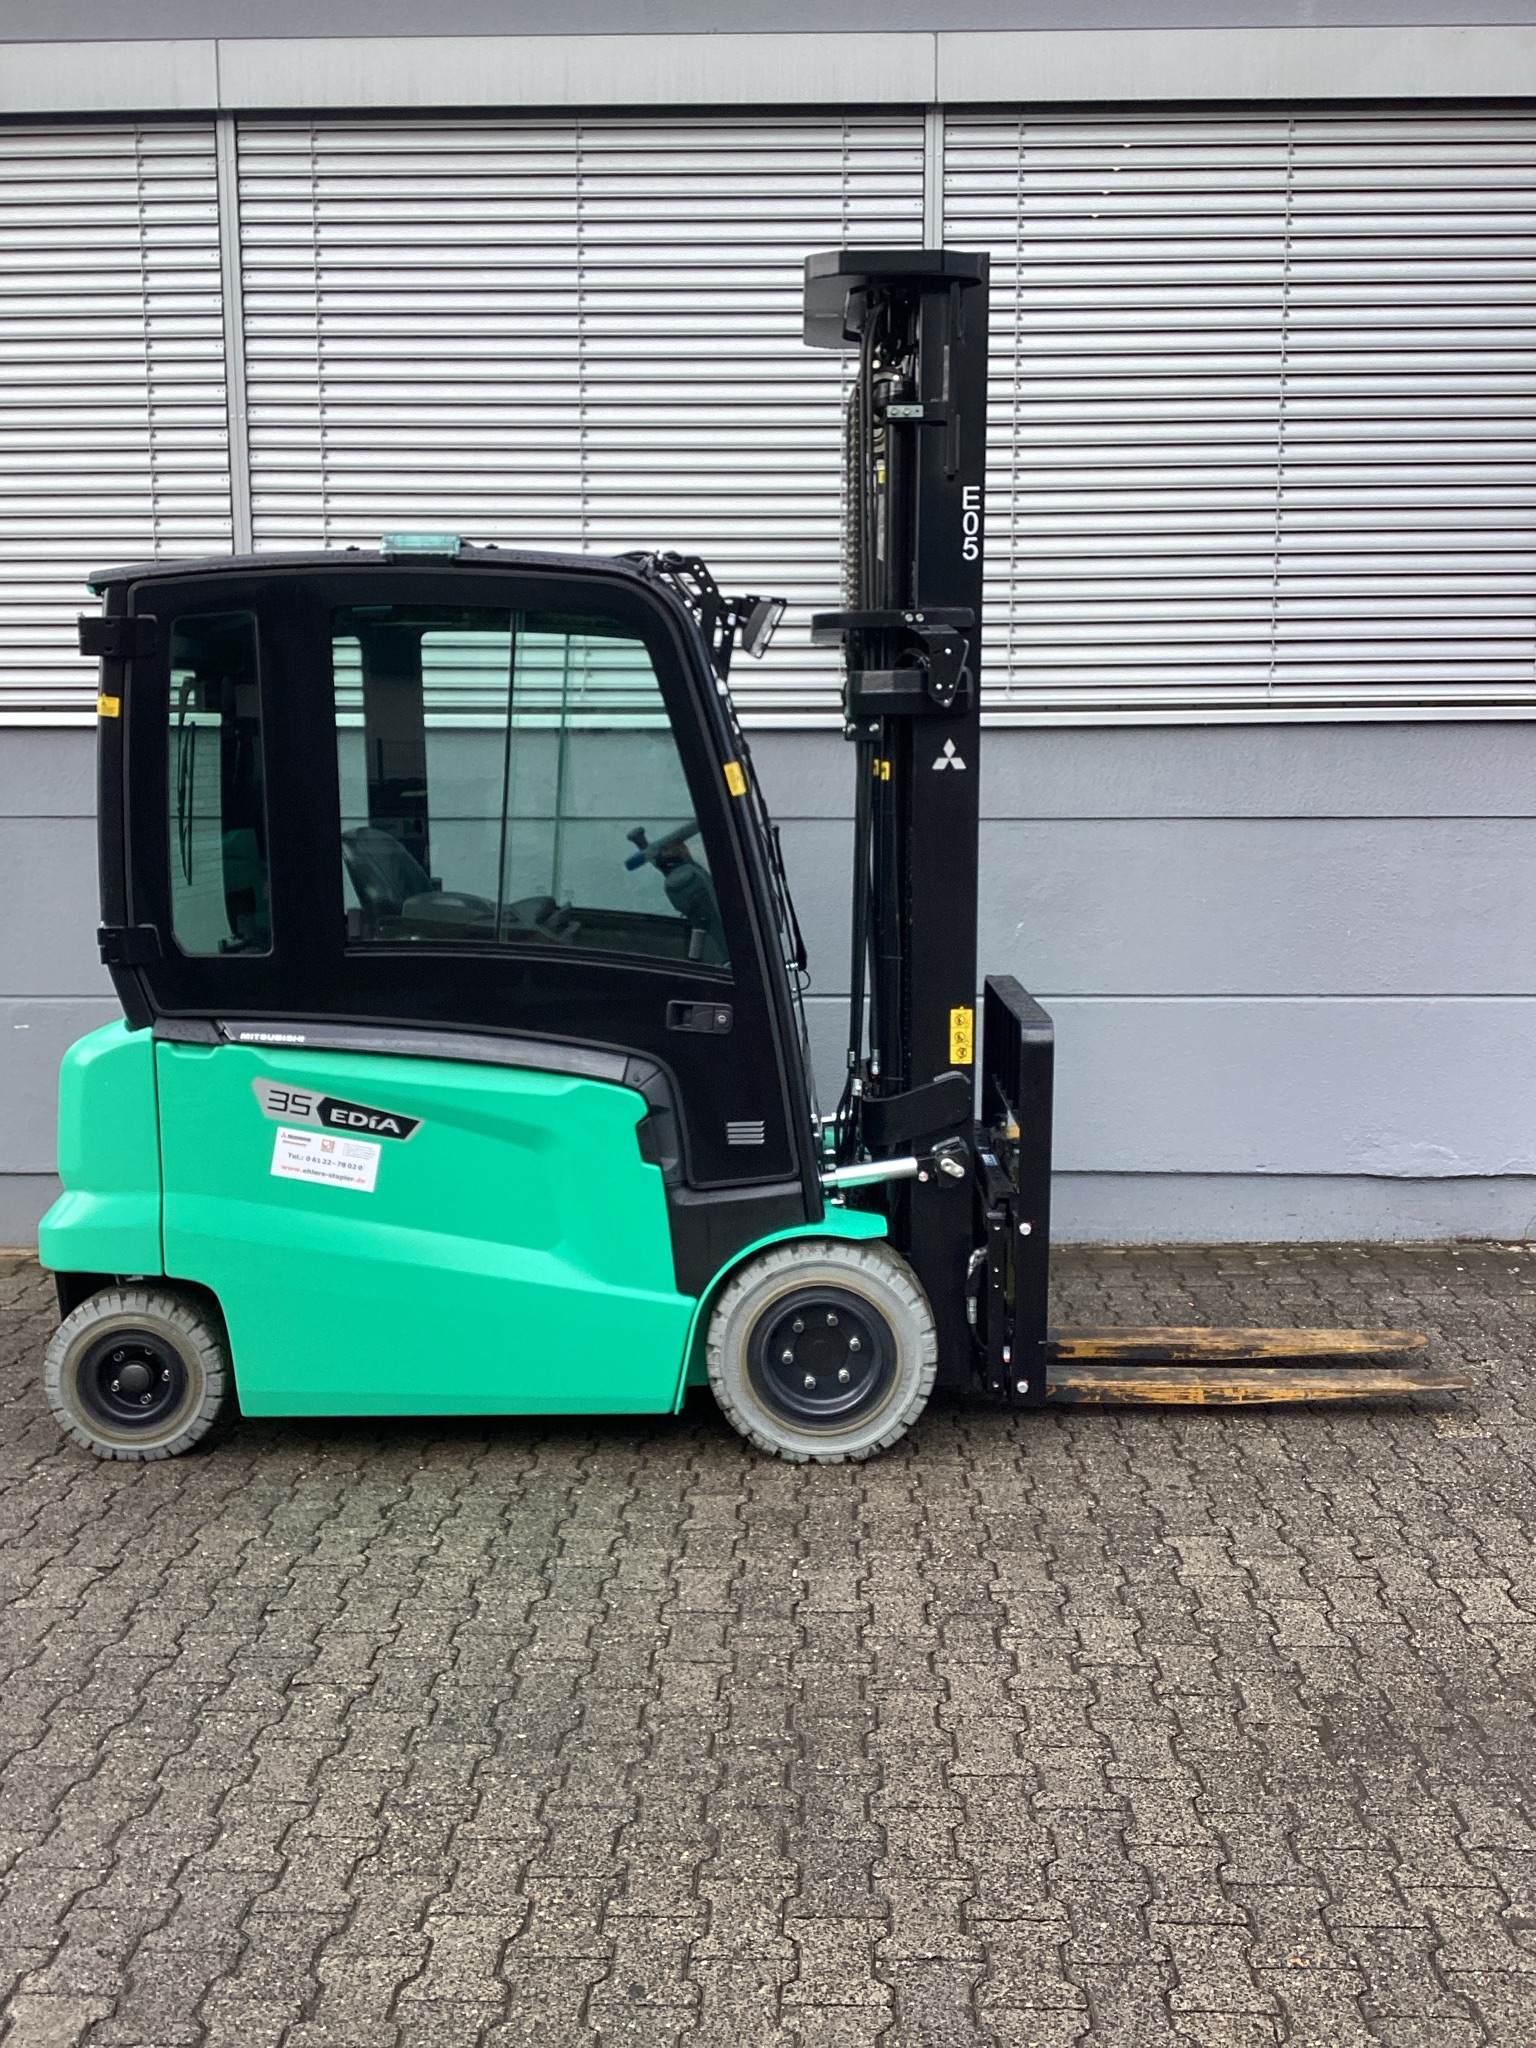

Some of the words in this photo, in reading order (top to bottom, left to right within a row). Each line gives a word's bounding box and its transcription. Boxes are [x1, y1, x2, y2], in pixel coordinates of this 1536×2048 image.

[962, 485, 981, 561] E05
[240, 1032, 305, 1042] MITSUBISHI
[267, 1089, 312, 1116] 35
[288, 1152, 304, 1161] Tel.:
